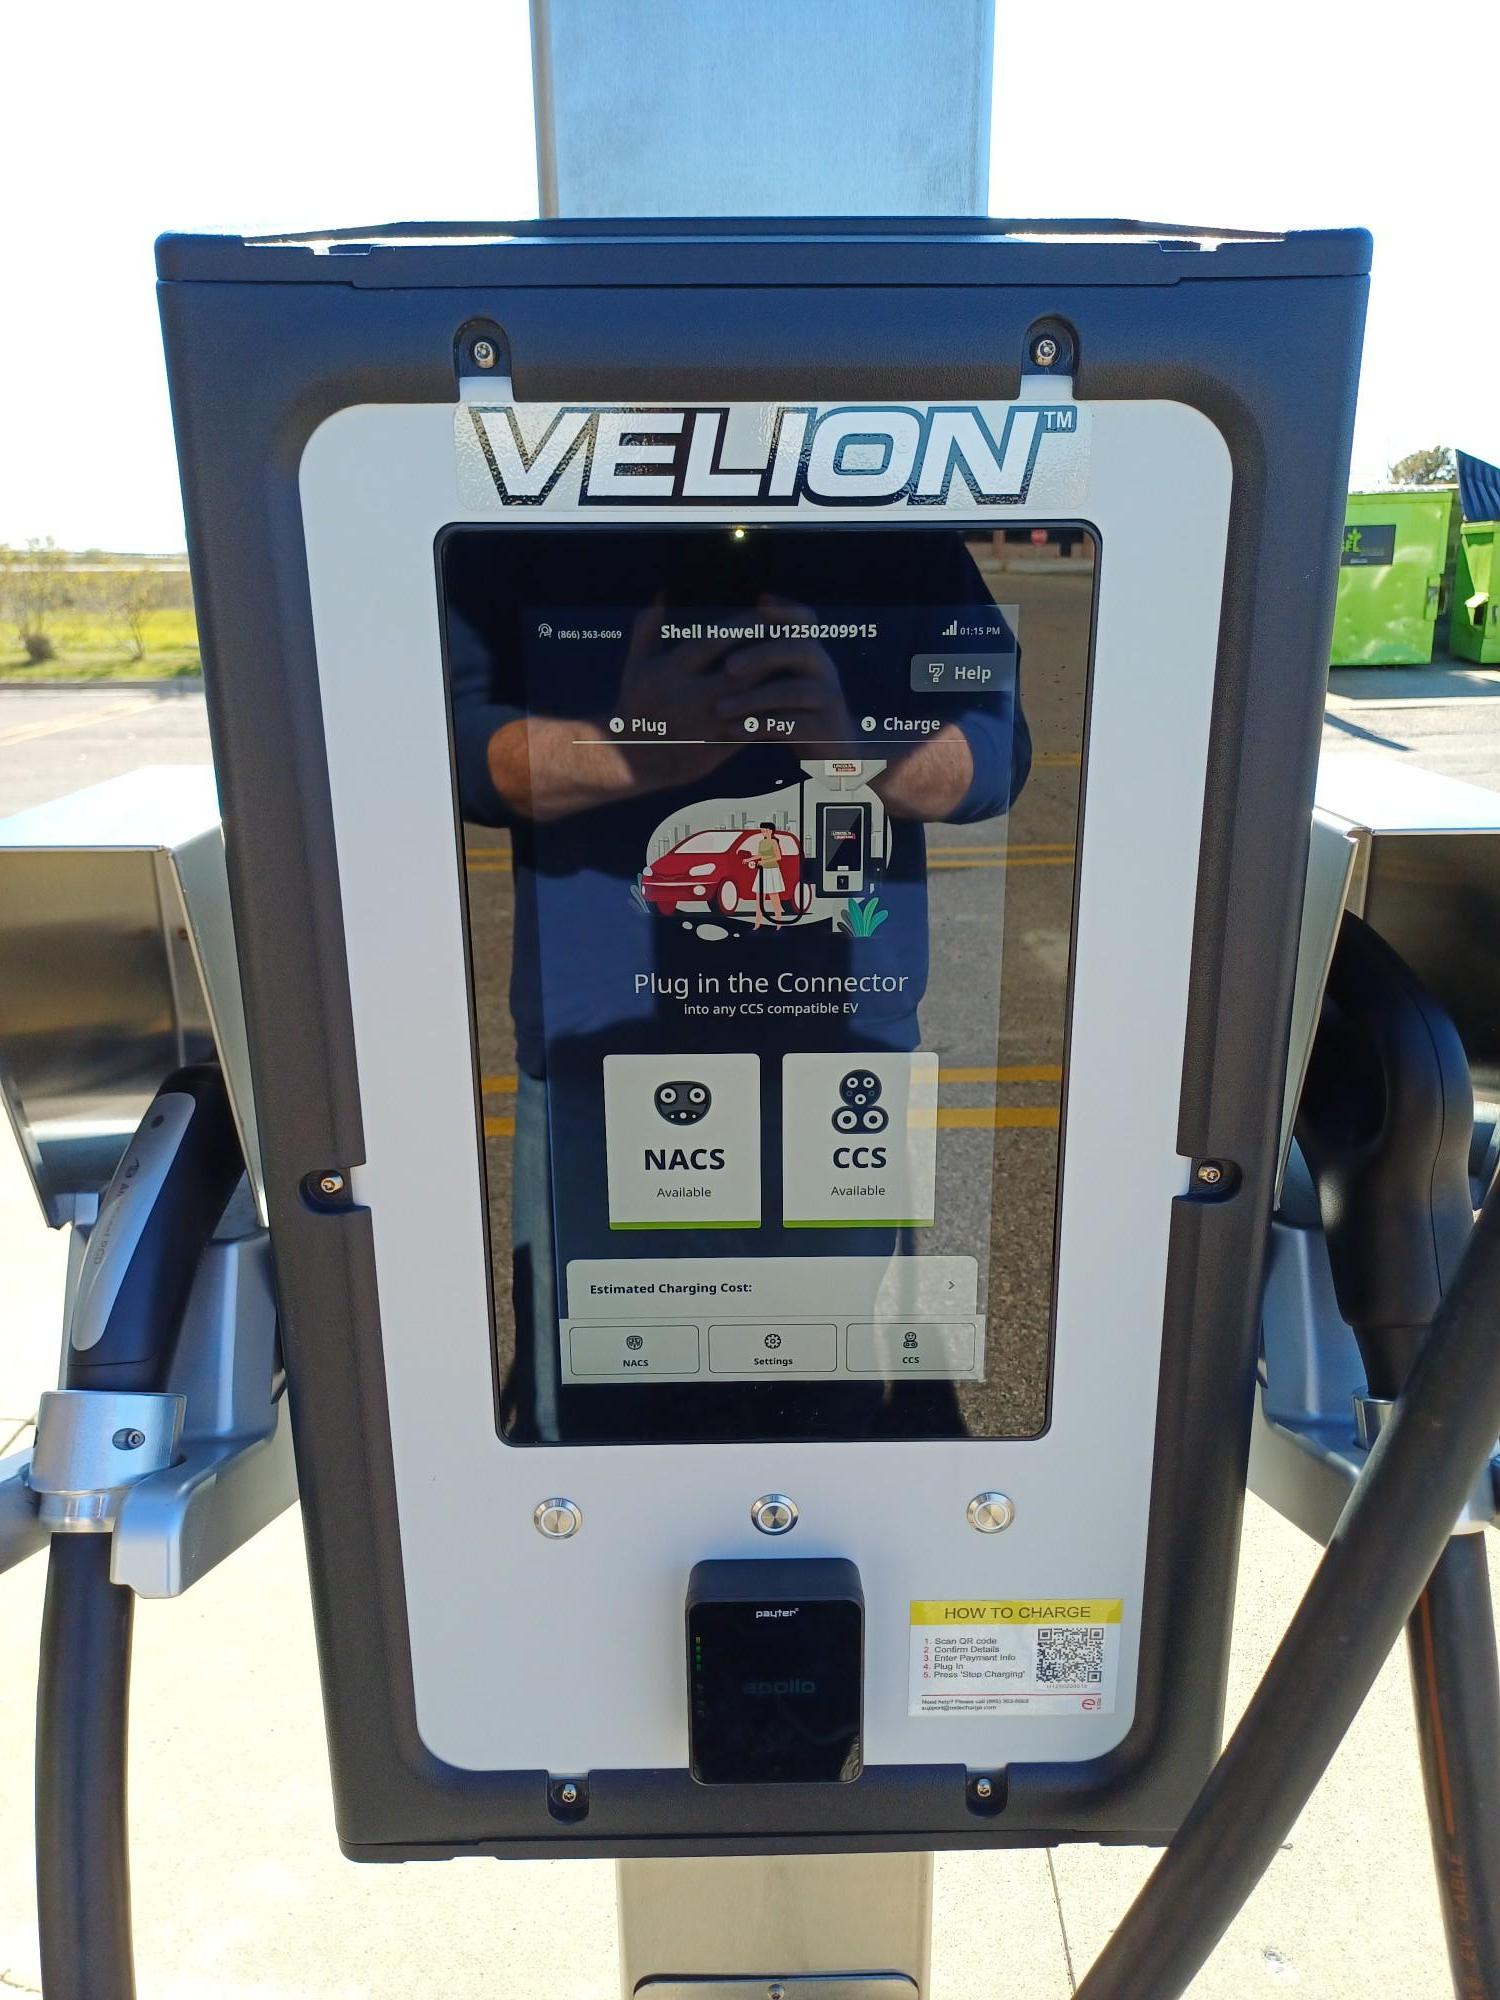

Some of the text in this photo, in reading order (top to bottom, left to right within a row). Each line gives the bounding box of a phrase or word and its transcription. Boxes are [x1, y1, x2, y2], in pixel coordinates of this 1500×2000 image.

[557, 630, 622, 640] (866) 363-6069
[660, 624, 877, 639] Shell Howell U1250209915
[959, 626, 1001, 636] 01:15 PM
[954, 666, 992, 684] Help
[631, 718, 667, 736] Plug
[766, 718, 795, 735] Pay
[883, 717, 941, 734] Charge
[634, 972, 909, 999] Plug in the Connector
[713, 1005, 737, 1018] any
[740, 1003, 763, 1014] CCS
[767, 1002, 839, 1017] compatible
[843, 1002, 859, 1014] EV
[644, 1148, 726, 1171] NACS
[832, 1147, 888, 1169] CCS
[657, 1186, 712, 1198] Available
[830, 1185, 886, 1197] Available
[590, 1281, 752, 1296] Estimated Charging Cost:
[622, 1357, 649, 1368] NACS
[753, 1356, 793, 1368] Settings
[901, 1355, 920, 1365] CCS
[944, 1606, 1092, 1619] HOW TO CHARGE
[934, 1637, 957, 1645] Scan
[959, 1637, 974, 1645] QR
[975, 1637, 997, 1645] code
[959, 1654, 998, 1663] Payment
[934, 1663, 953, 1671] Plug
[743, 1679, 817, 1695] apollo
